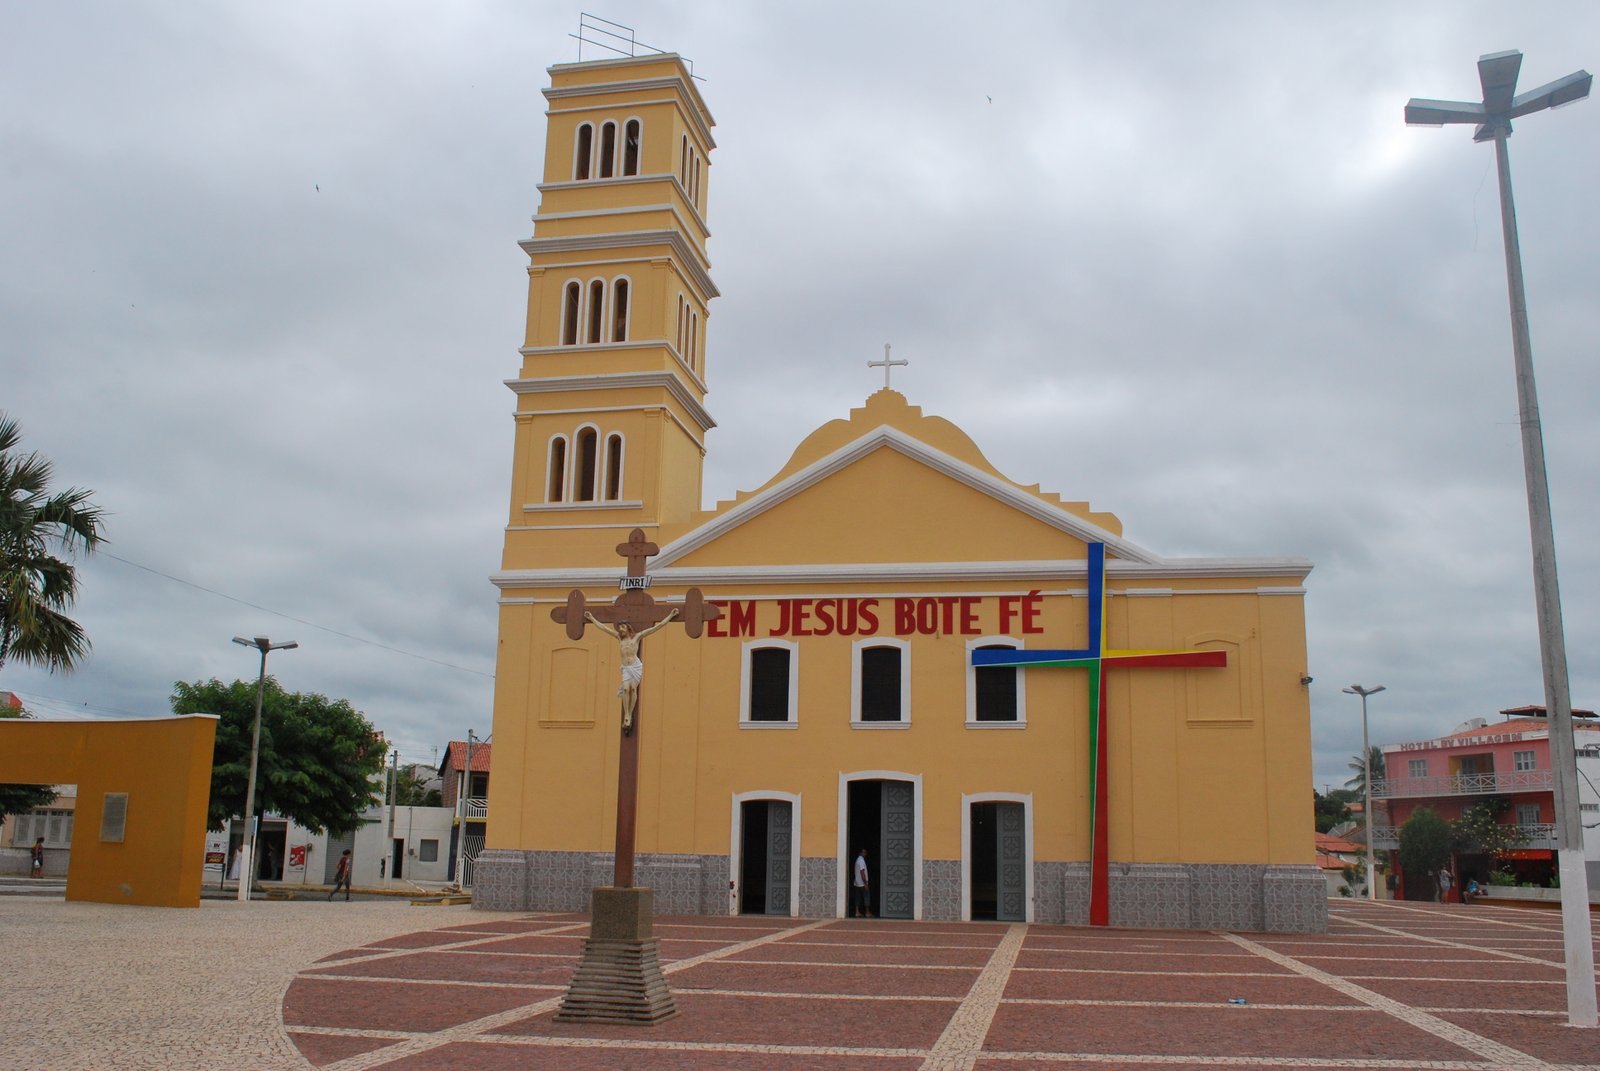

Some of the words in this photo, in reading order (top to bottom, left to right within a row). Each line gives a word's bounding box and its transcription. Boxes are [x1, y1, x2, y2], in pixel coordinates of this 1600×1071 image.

[625, 577, 645, 587] INRI
[707, 599, 756, 638] EM
[769, 598, 879, 636] JESUS
[894, 596, 982, 636] BOTE
[999, 590, 1044, 634] FÉ
[1400, 741, 1437, 751] HOTEL
